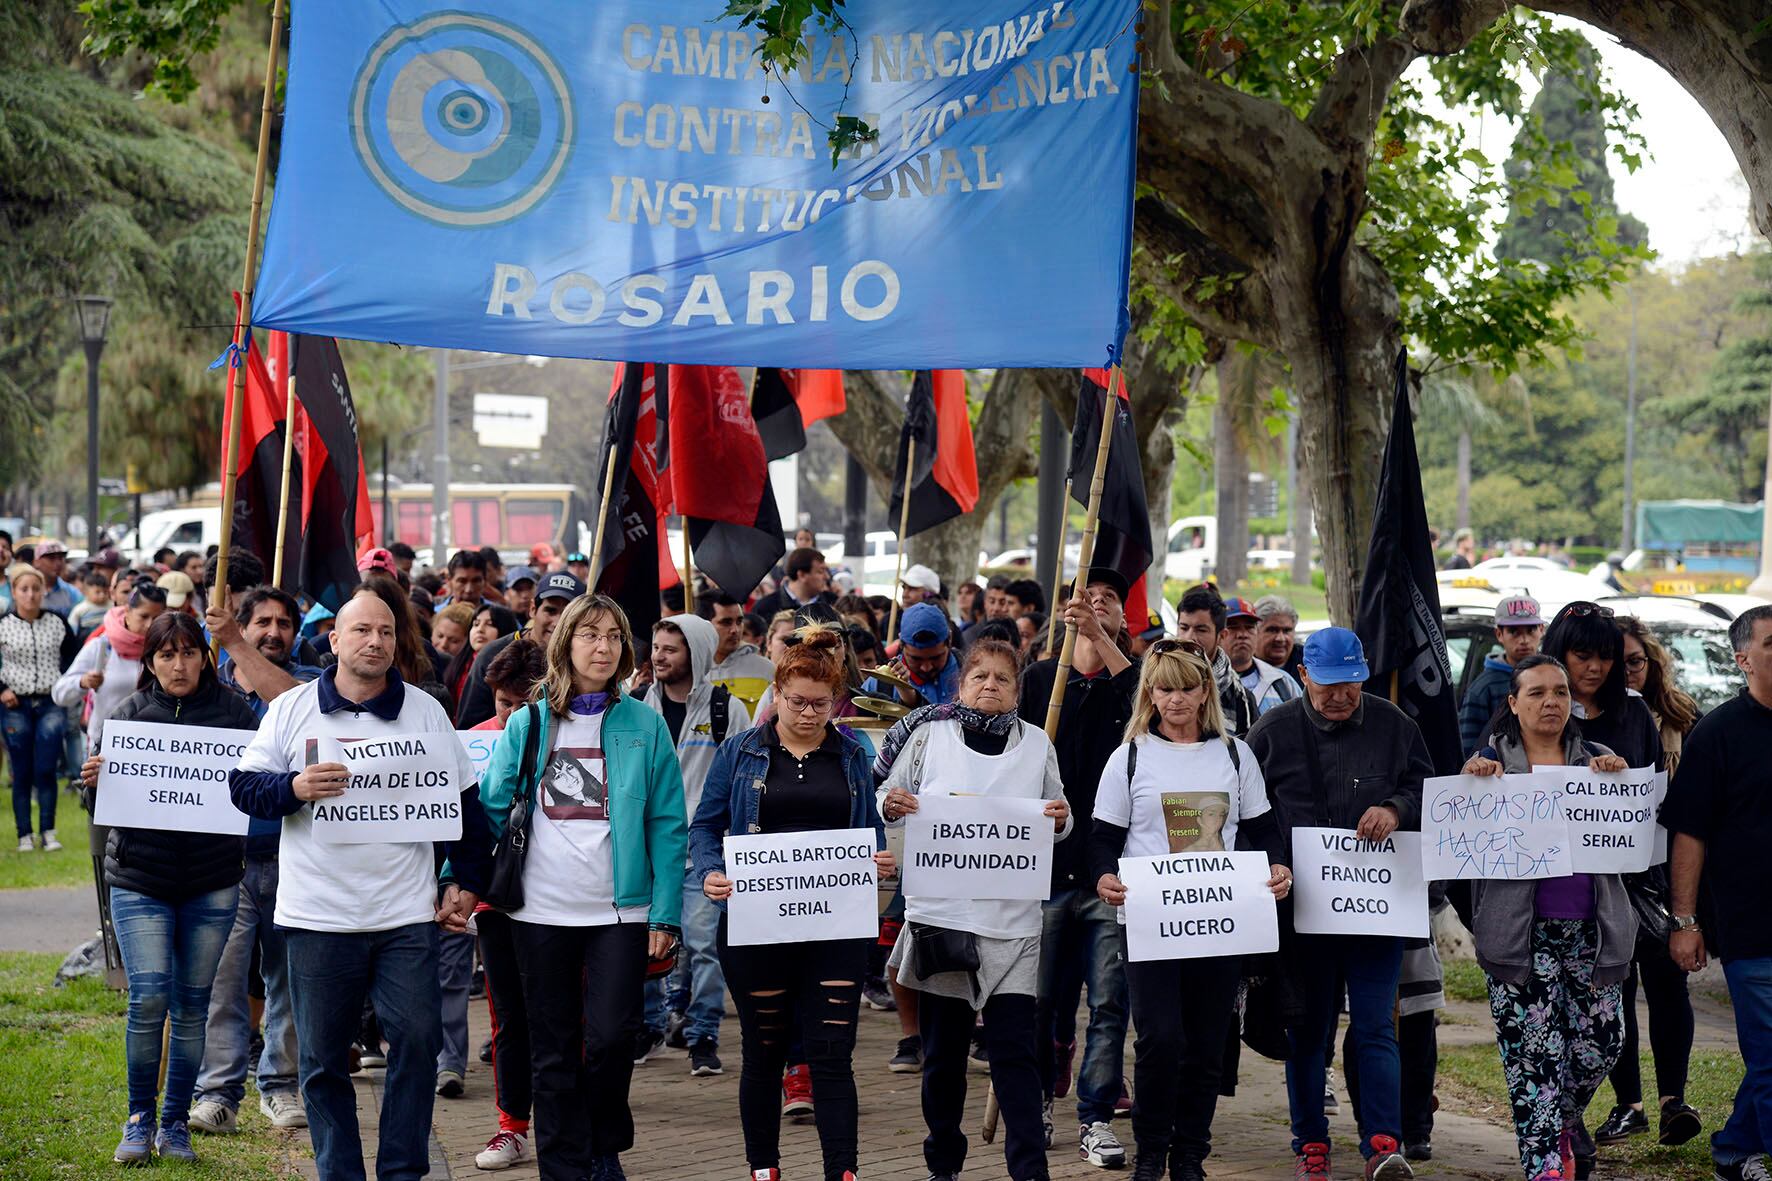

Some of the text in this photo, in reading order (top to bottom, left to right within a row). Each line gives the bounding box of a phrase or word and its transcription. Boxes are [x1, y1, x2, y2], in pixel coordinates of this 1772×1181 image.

[871, 1, 1076, 83] NACIONAL
[614, 100, 816, 160] CONTRA
[486, 260, 900, 328] ROSARIO
[1506, 600, 1537, 617] VANS
[112, 735, 247, 757] FISCAL BARTOCC
[343, 739, 427, 760] VICTIMA
[108, 761, 230, 782] DESESTIMADO
[387, 772, 410, 789] DE
[415, 771, 449, 788] LOS
[148, 789, 204, 806] SERIAL
[1565, 781, 1595, 796] CAL
[1162, 797, 1187, 806] Fabian
[1431, 789, 1565, 824] GRACIAS POR
[314, 802, 460, 822] ANGELES PARIS
[1173, 809, 1202, 818] Siempre
[1565, 805, 1651, 823] RCHIVADORA
[932, 823, 1031, 841] ¡BASTA DE
[1169, 827, 1200, 837] Presente
[1436, 826, 1530, 857] HACER
[1582, 833, 1635, 849] SERIAL
[1321, 833, 1396, 853] VICTIMA
[734, 844, 872, 866] FISCAL BARTOCCI
[915, 852, 1037, 871] IMPUNIDAD!
[1151, 857, 1235, 876] VICTIMA
[1321, 865, 1392, 884] FRANCO
[736, 871, 874, 893] DESESTIMADORA
[1162, 886, 1233, 906] FABIAN
[778, 900, 832, 917] SERIAL
[1331, 897, 1389, 915] CASCO
[1159, 917, 1235, 938] LUCERO
